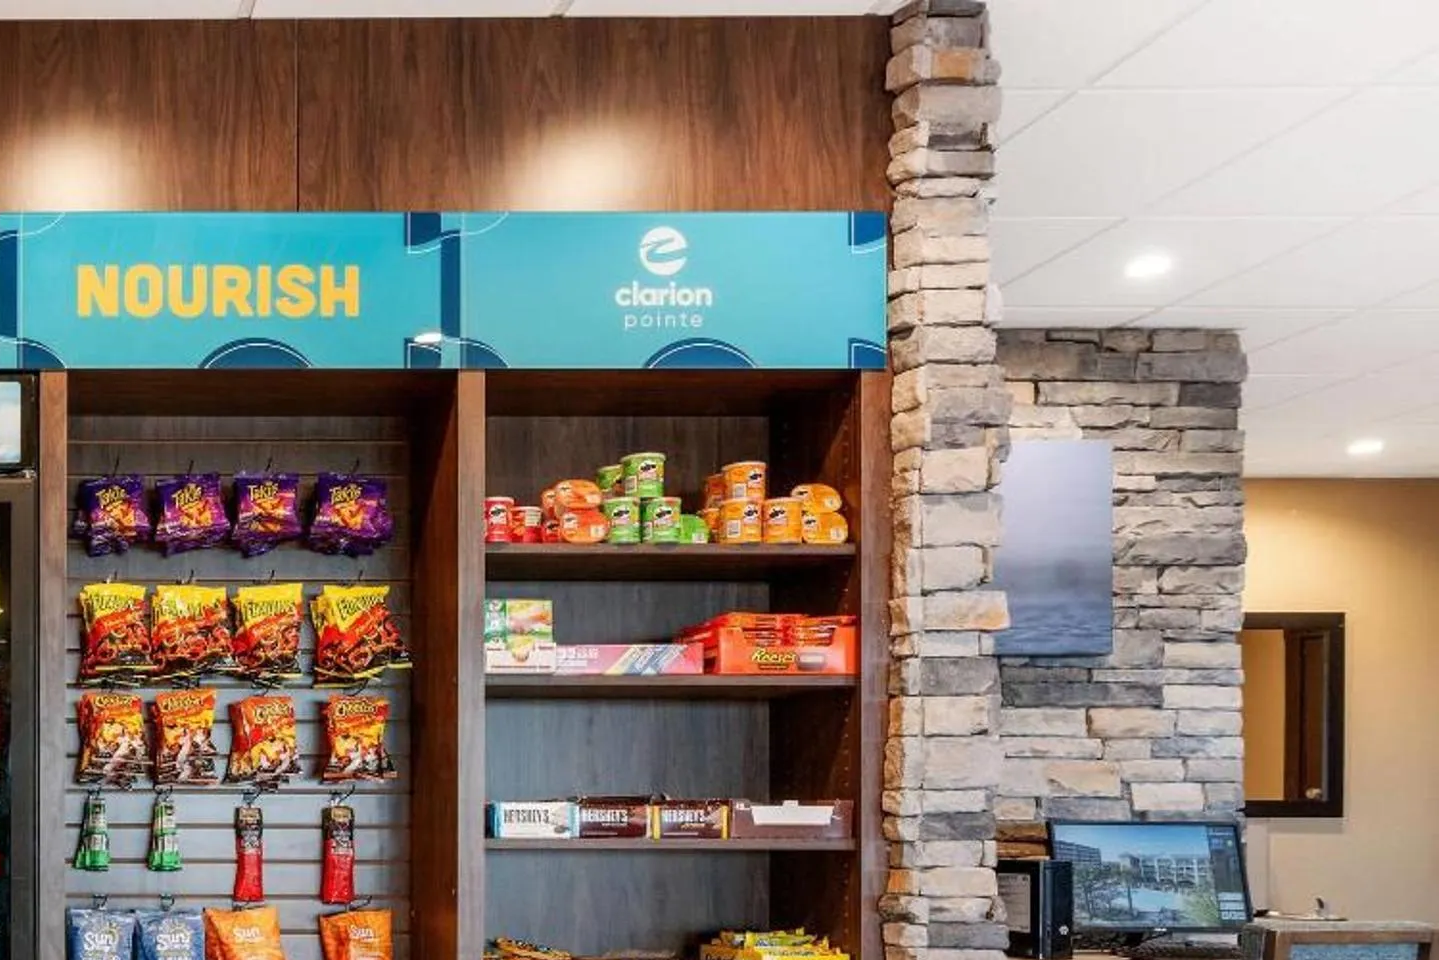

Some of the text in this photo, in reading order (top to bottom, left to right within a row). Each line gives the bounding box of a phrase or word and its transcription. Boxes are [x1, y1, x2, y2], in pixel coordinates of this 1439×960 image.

[75, 263, 361, 317] NOURISH
[615, 280, 714, 308] clarion
[623, 309, 705, 330] pointe
[171, 484, 203, 508] Takis
[248, 481, 280, 502] Takis
